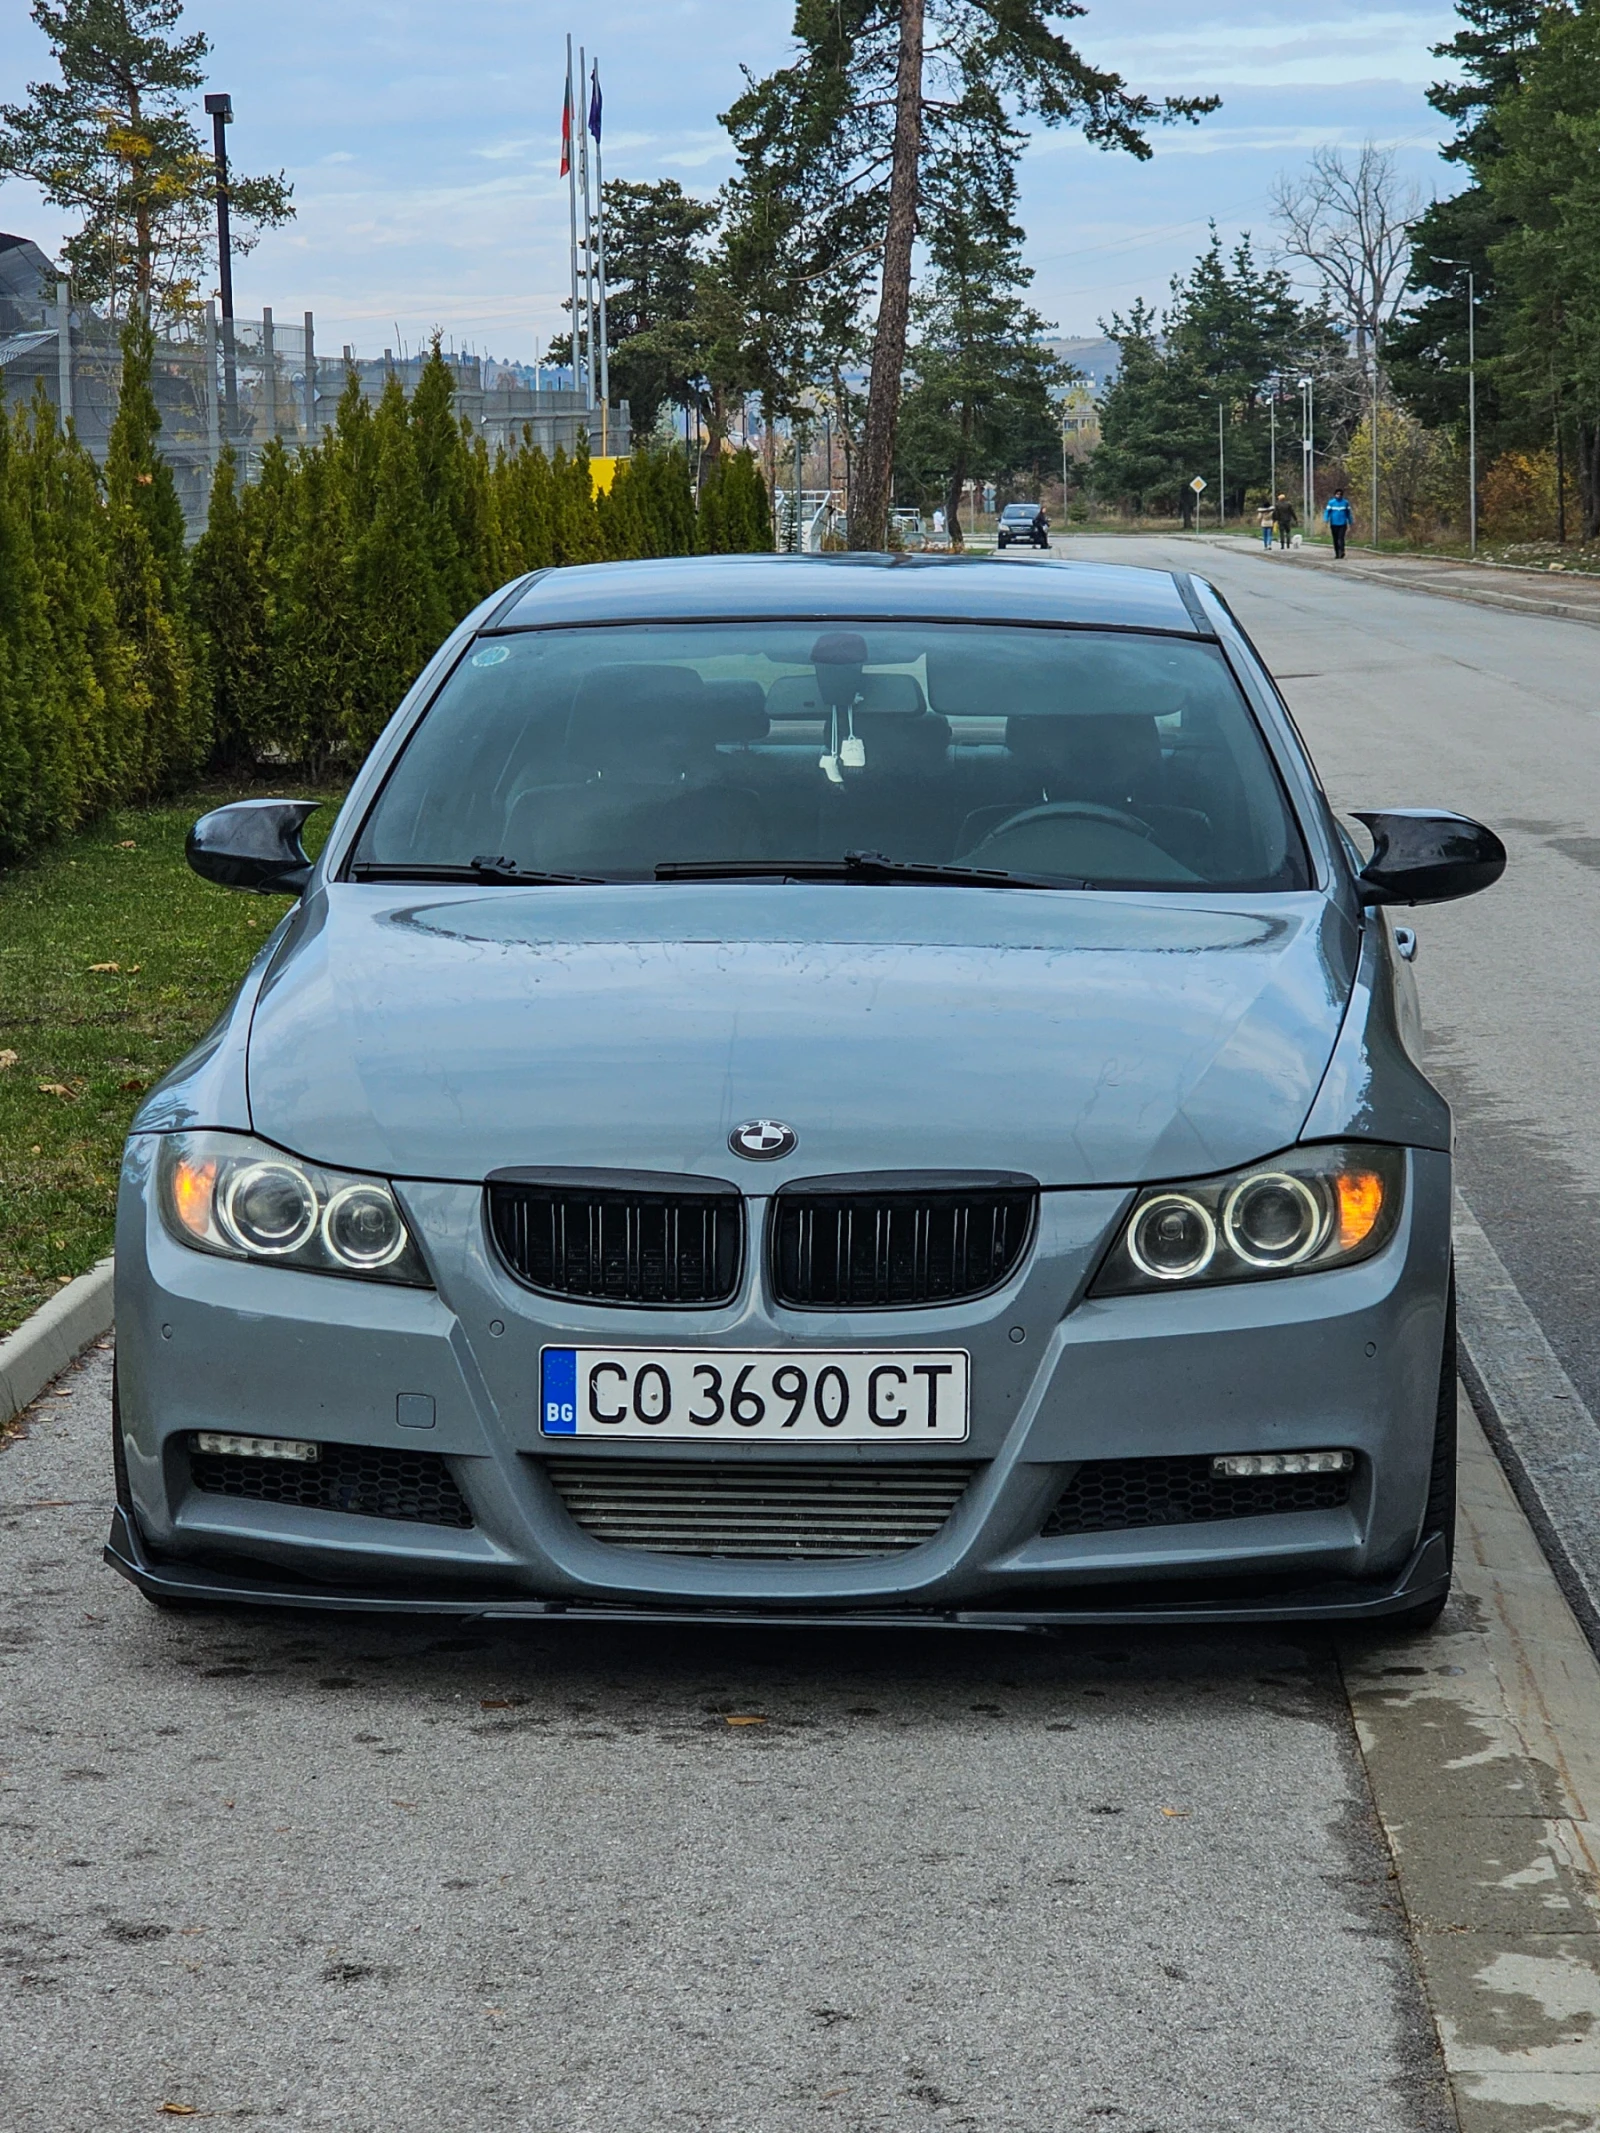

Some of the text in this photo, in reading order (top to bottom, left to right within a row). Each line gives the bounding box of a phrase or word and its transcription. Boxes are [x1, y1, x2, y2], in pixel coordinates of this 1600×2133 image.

[737, 1120, 792, 1134] BMW
[688, 1363, 850, 1428] 3690
[867, 1364, 953, 1428] CT
[546, 1402, 574, 1422] BG
